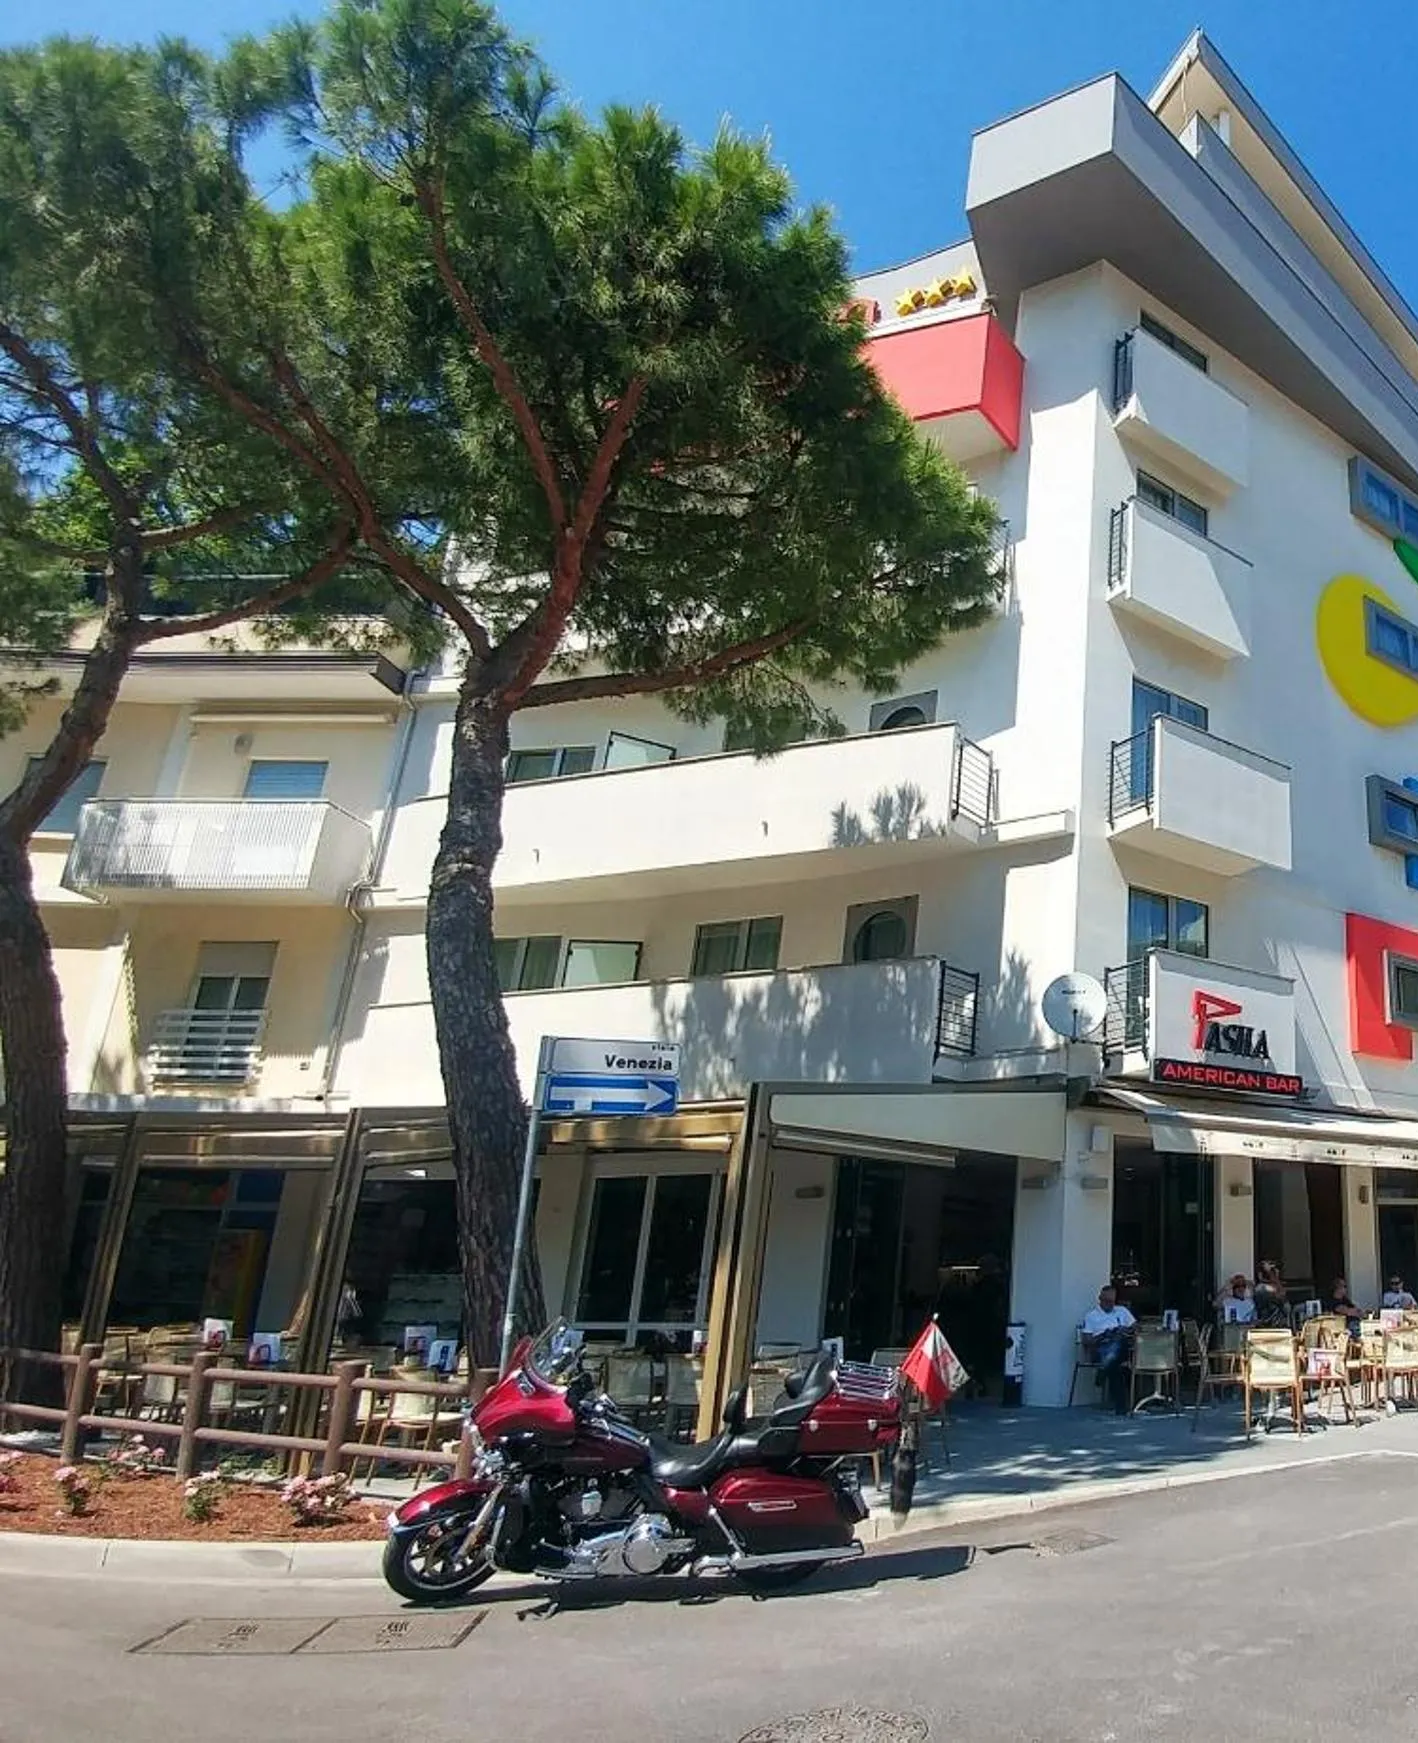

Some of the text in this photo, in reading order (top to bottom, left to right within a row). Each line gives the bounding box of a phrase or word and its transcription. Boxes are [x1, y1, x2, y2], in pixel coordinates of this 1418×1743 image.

[604, 1054, 673, 1071] Venezia
[1162, 1063, 1301, 1094] AMERICAN BAR
